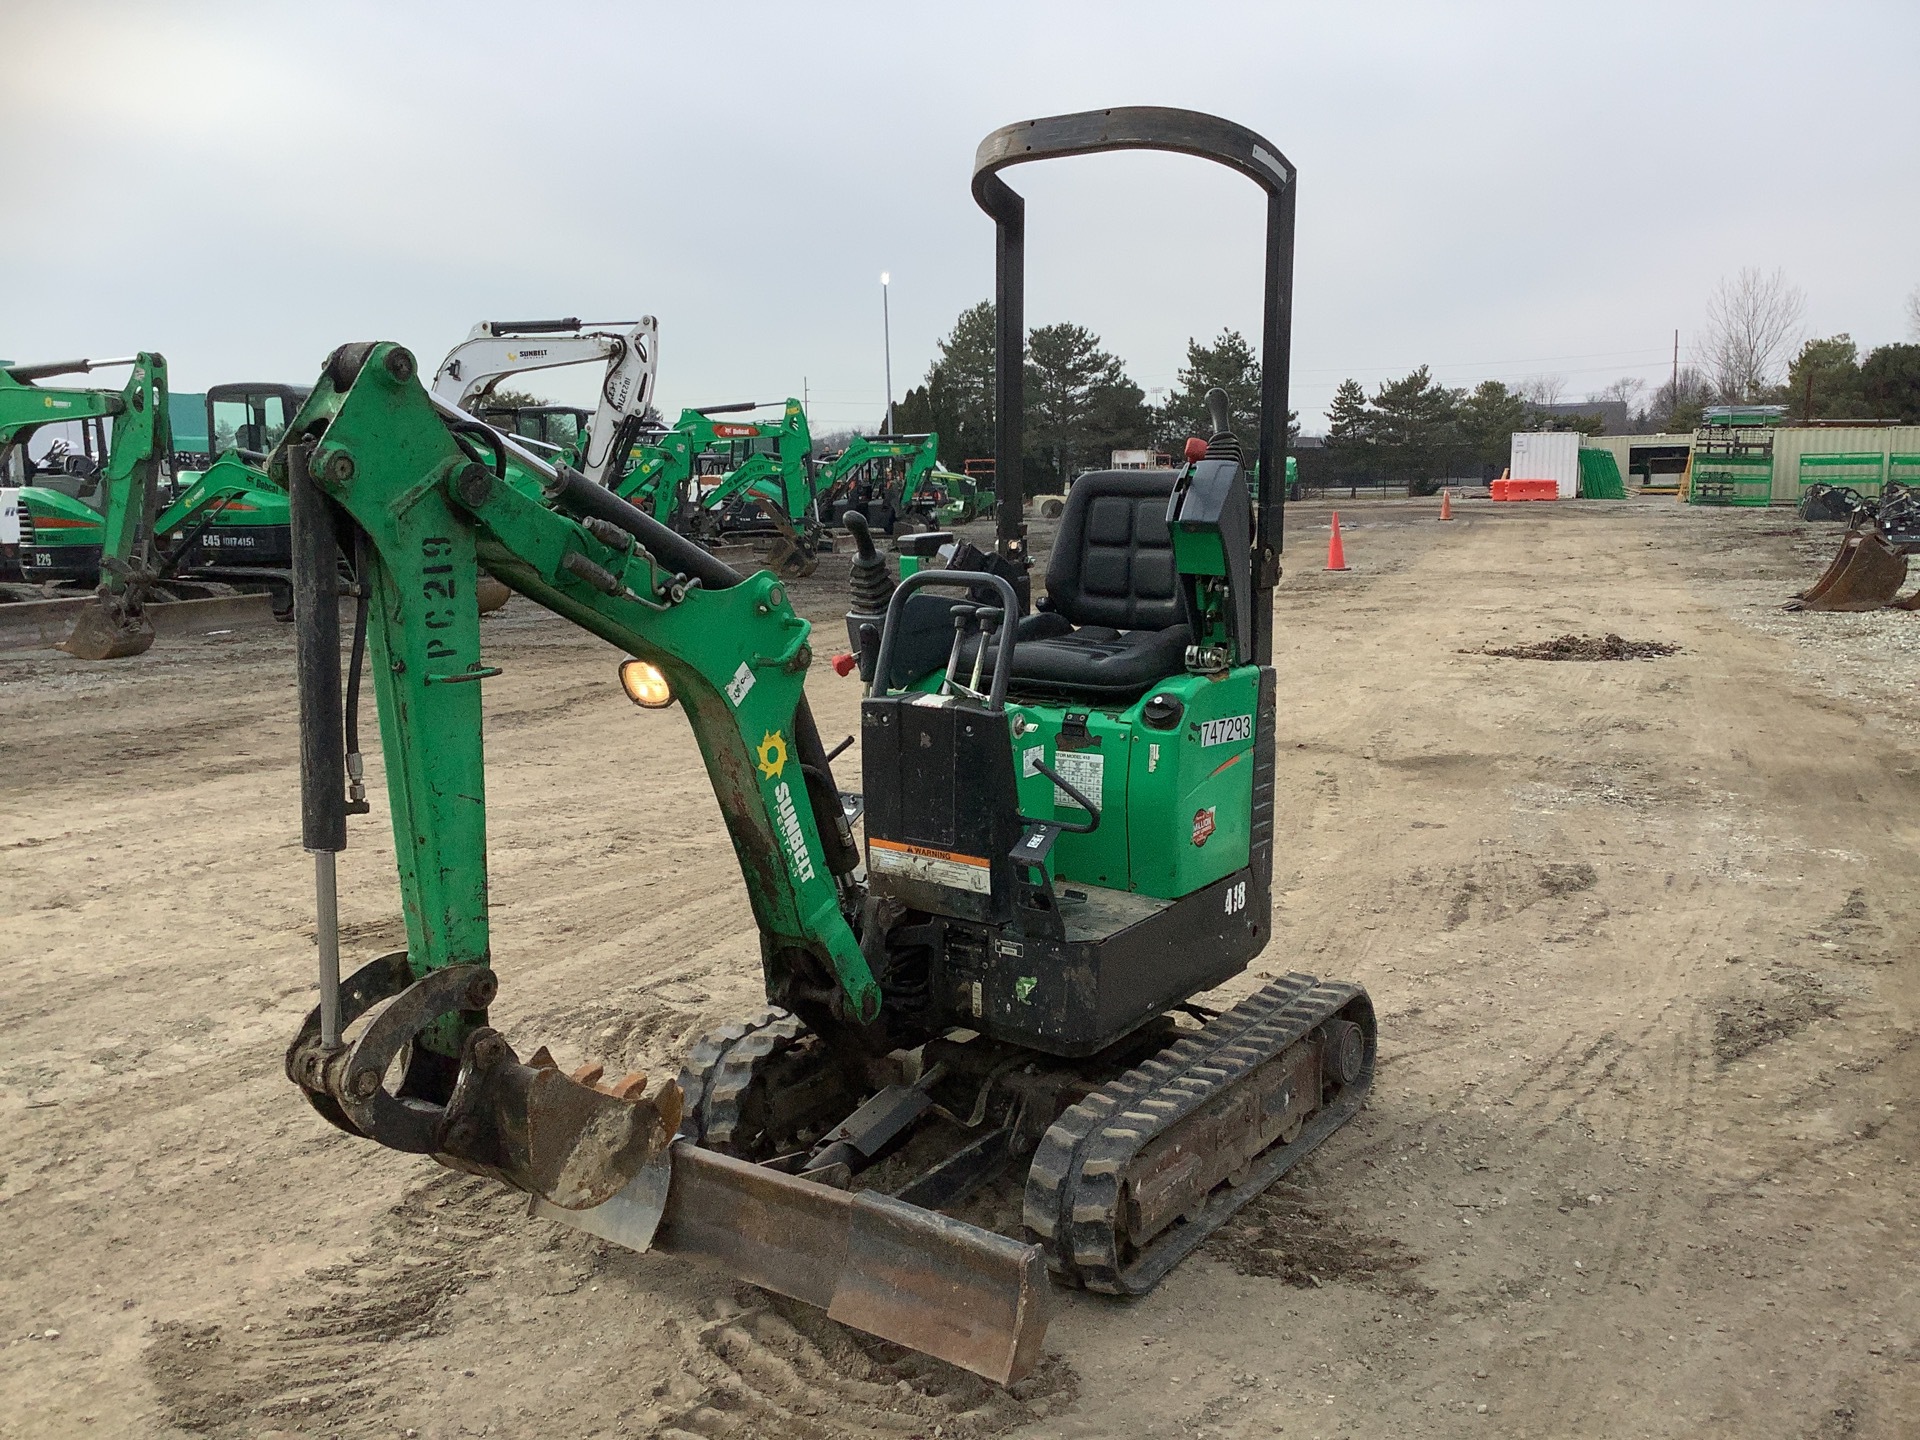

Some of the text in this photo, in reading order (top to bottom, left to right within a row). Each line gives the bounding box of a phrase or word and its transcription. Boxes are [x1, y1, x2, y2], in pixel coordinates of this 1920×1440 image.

[519, 349, 548, 357] SUNBELT
[202, 535, 221, 547] E45
[36, 553, 52, 567] E26
[1202, 716, 1251, 746] 747293
[775, 781, 815, 884] SUNBELT
[914, 847, 951, 860] WARNING
[1224, 881, 1246, 916] 418
